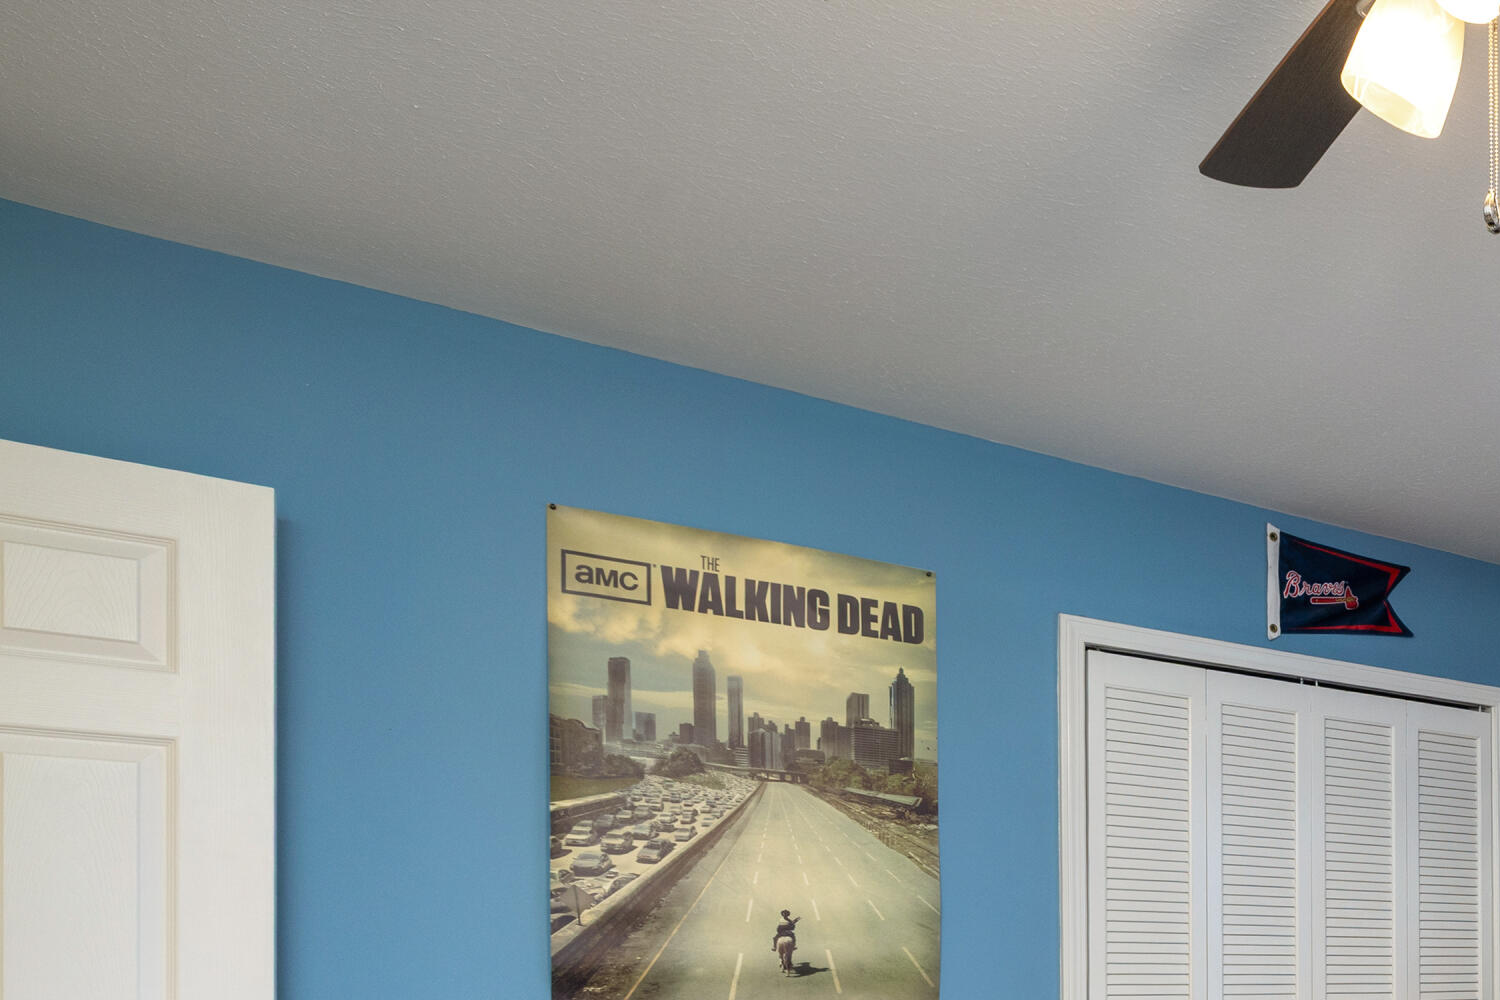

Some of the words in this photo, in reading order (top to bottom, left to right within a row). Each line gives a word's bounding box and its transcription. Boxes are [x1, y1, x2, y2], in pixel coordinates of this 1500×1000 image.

[700, 555, 720, 572] THE
[1283, 570, 1345, 598] Braves
[660, 564, 830, 631] WALKING
[837, 593, 924, 645] DEAD
